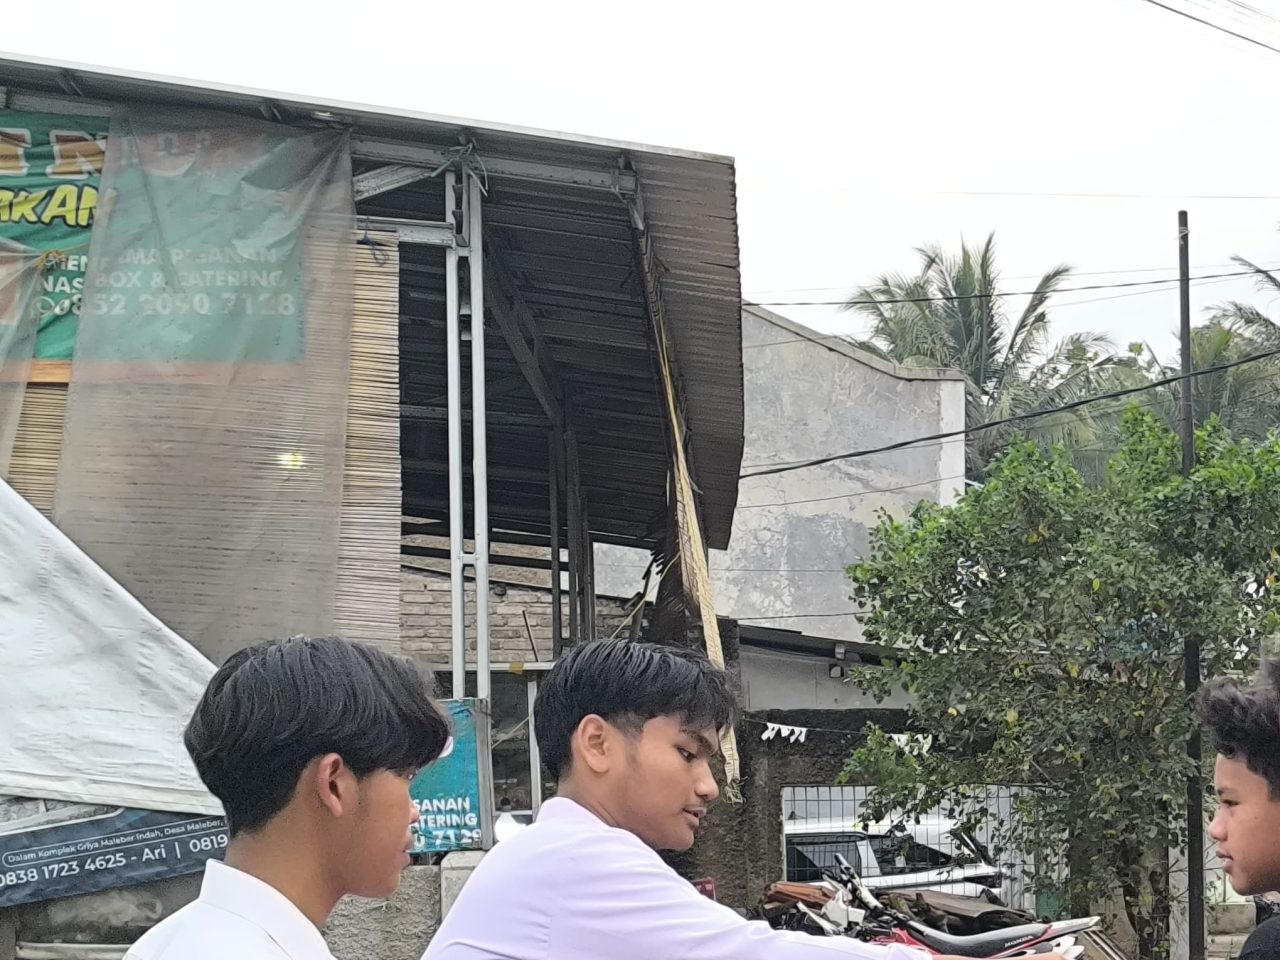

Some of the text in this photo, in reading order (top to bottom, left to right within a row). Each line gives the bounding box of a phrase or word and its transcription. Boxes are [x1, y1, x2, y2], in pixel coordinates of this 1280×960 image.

[96, 270, 142, 288] BOX
[151, 272, 167, 288] &
[8, 852, 37, 863] Dalam
[38, 845, 76, 858] Komplek
[77, 842, 99, 853] Griya
[101, 834, 135, 848] Maleber
[136, 830, 164, 841] Indah,
[164, 827, 186, 835] Desa
[41, 861, 80, 880] 1723
[84, 852, 127, 871] 4625
[142, 844, 167, 862] Ari
[189, 834, 228, 853] 0819
